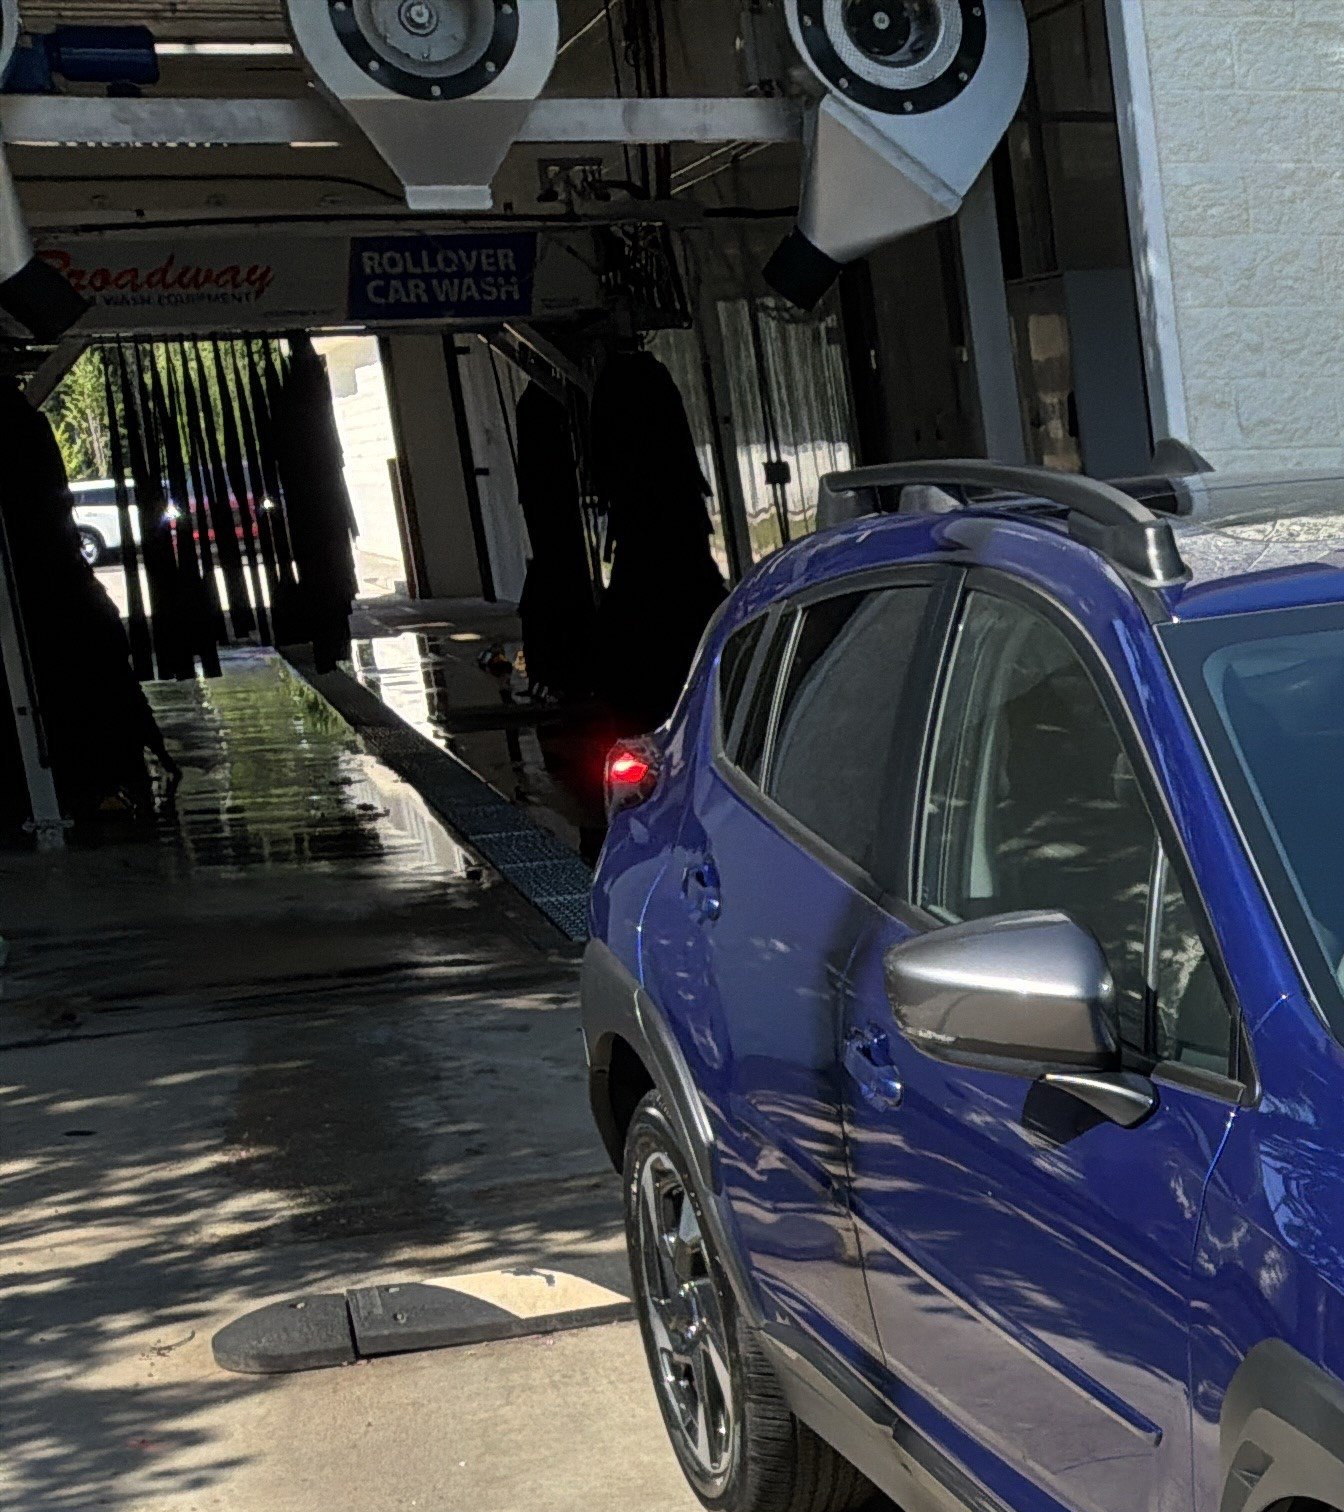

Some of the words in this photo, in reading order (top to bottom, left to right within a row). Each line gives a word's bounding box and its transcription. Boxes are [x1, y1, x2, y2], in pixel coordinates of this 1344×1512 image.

[363, 249, 516, 275] ROLLOVER
[367, 280, 428, 304] CAR
[430, 278, 520, 303] WASH
